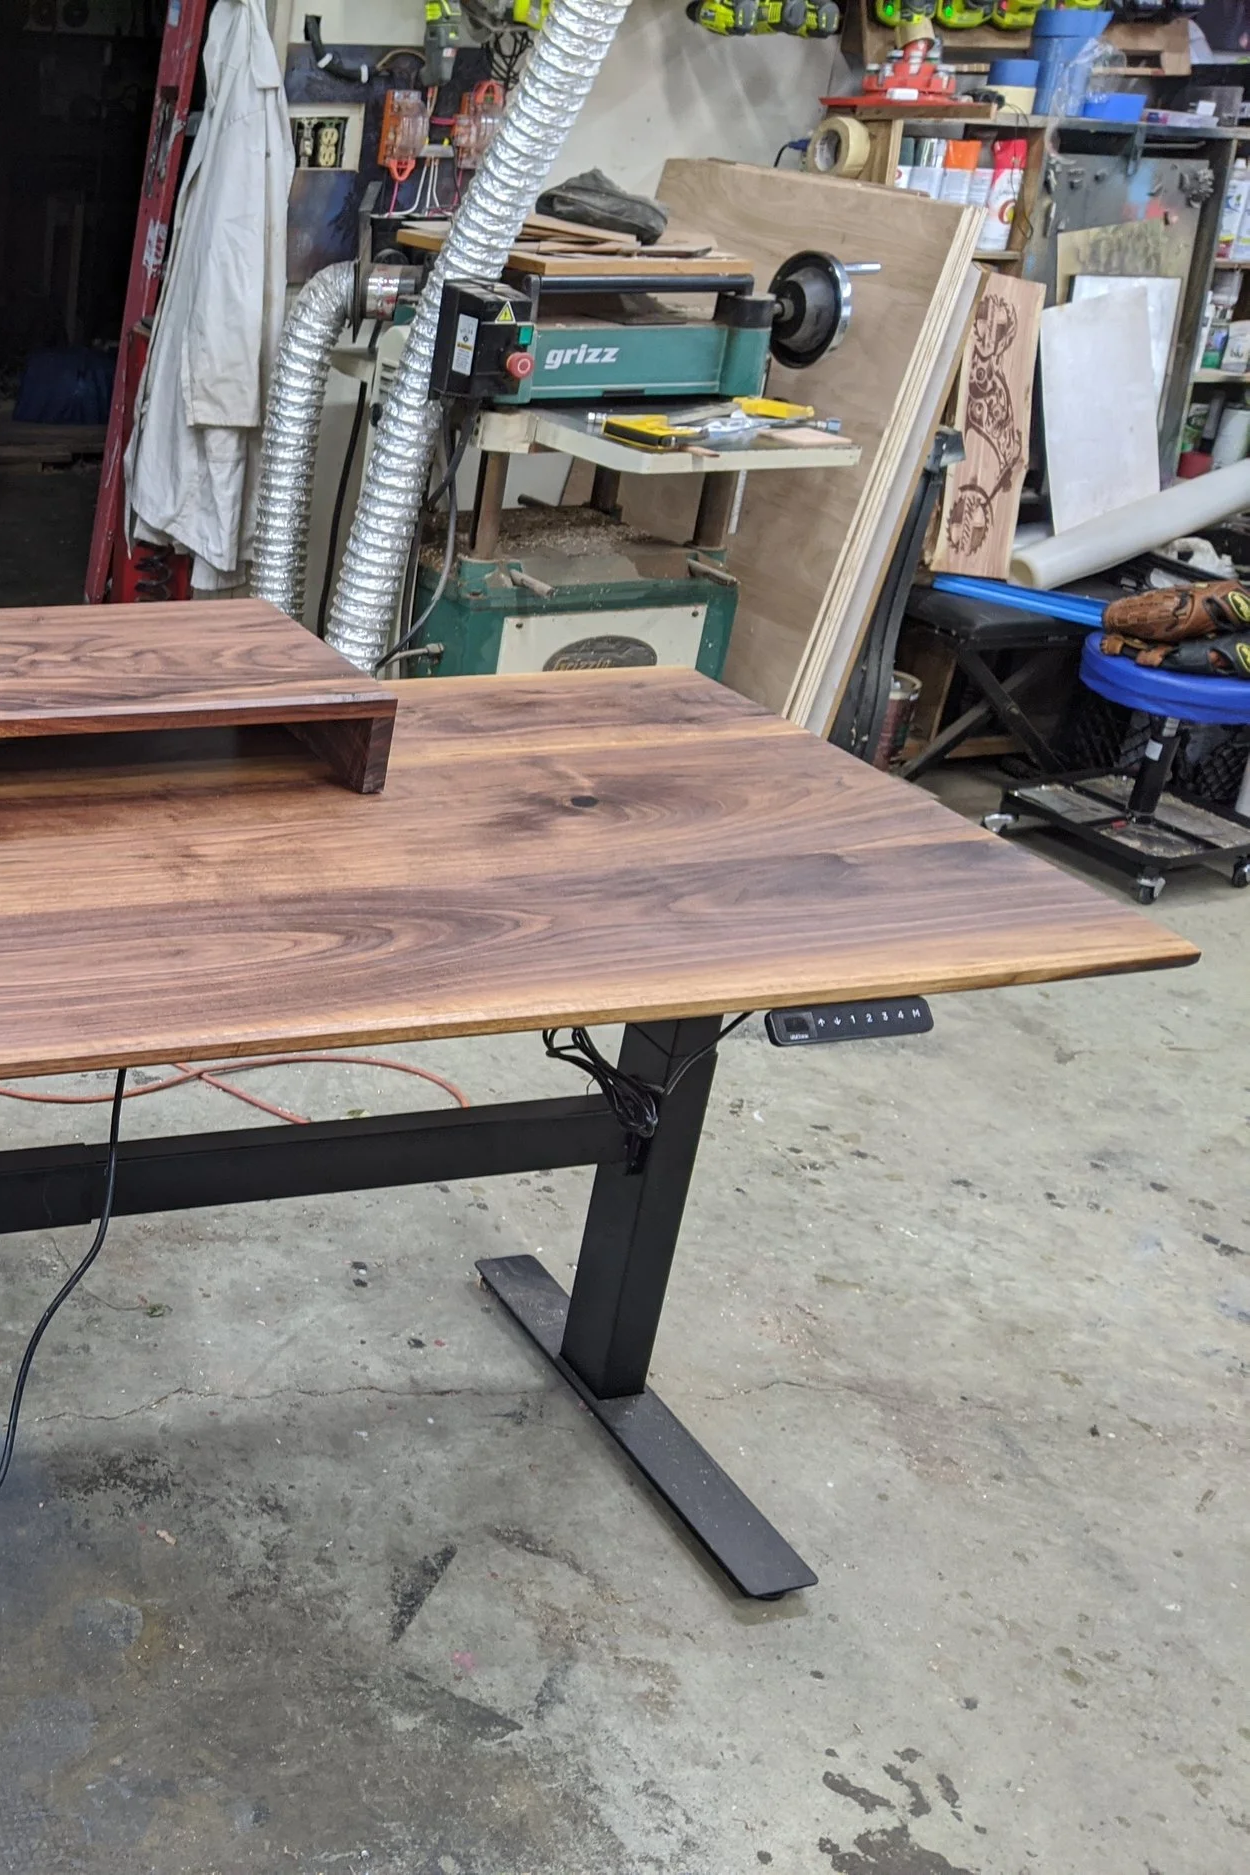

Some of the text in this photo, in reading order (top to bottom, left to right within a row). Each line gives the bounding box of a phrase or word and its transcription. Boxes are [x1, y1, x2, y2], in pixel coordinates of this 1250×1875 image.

[544, 343, 620, 370] grizz
[850, 1008, 921, 1024] 1 2 3 4 M
